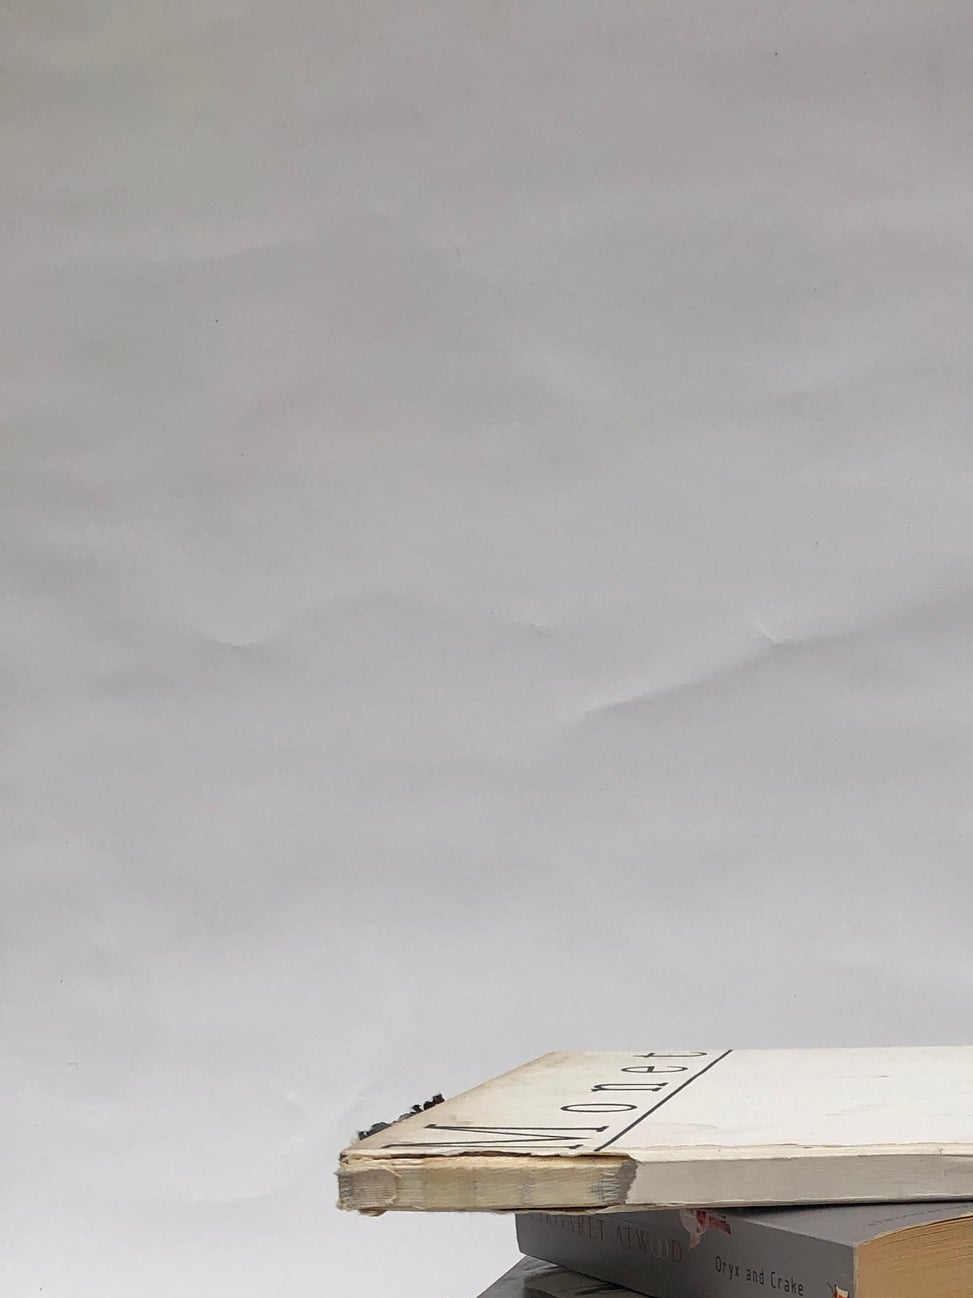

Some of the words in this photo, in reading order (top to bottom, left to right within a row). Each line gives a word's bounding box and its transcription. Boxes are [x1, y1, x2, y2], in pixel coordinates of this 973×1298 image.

[382, 1051, 708, 1150] Monet
[715, 1256, 740, 1281] Oryx
[746, 1268, 765, 1286] and
[770, 1271, 804, 1297] Crake
